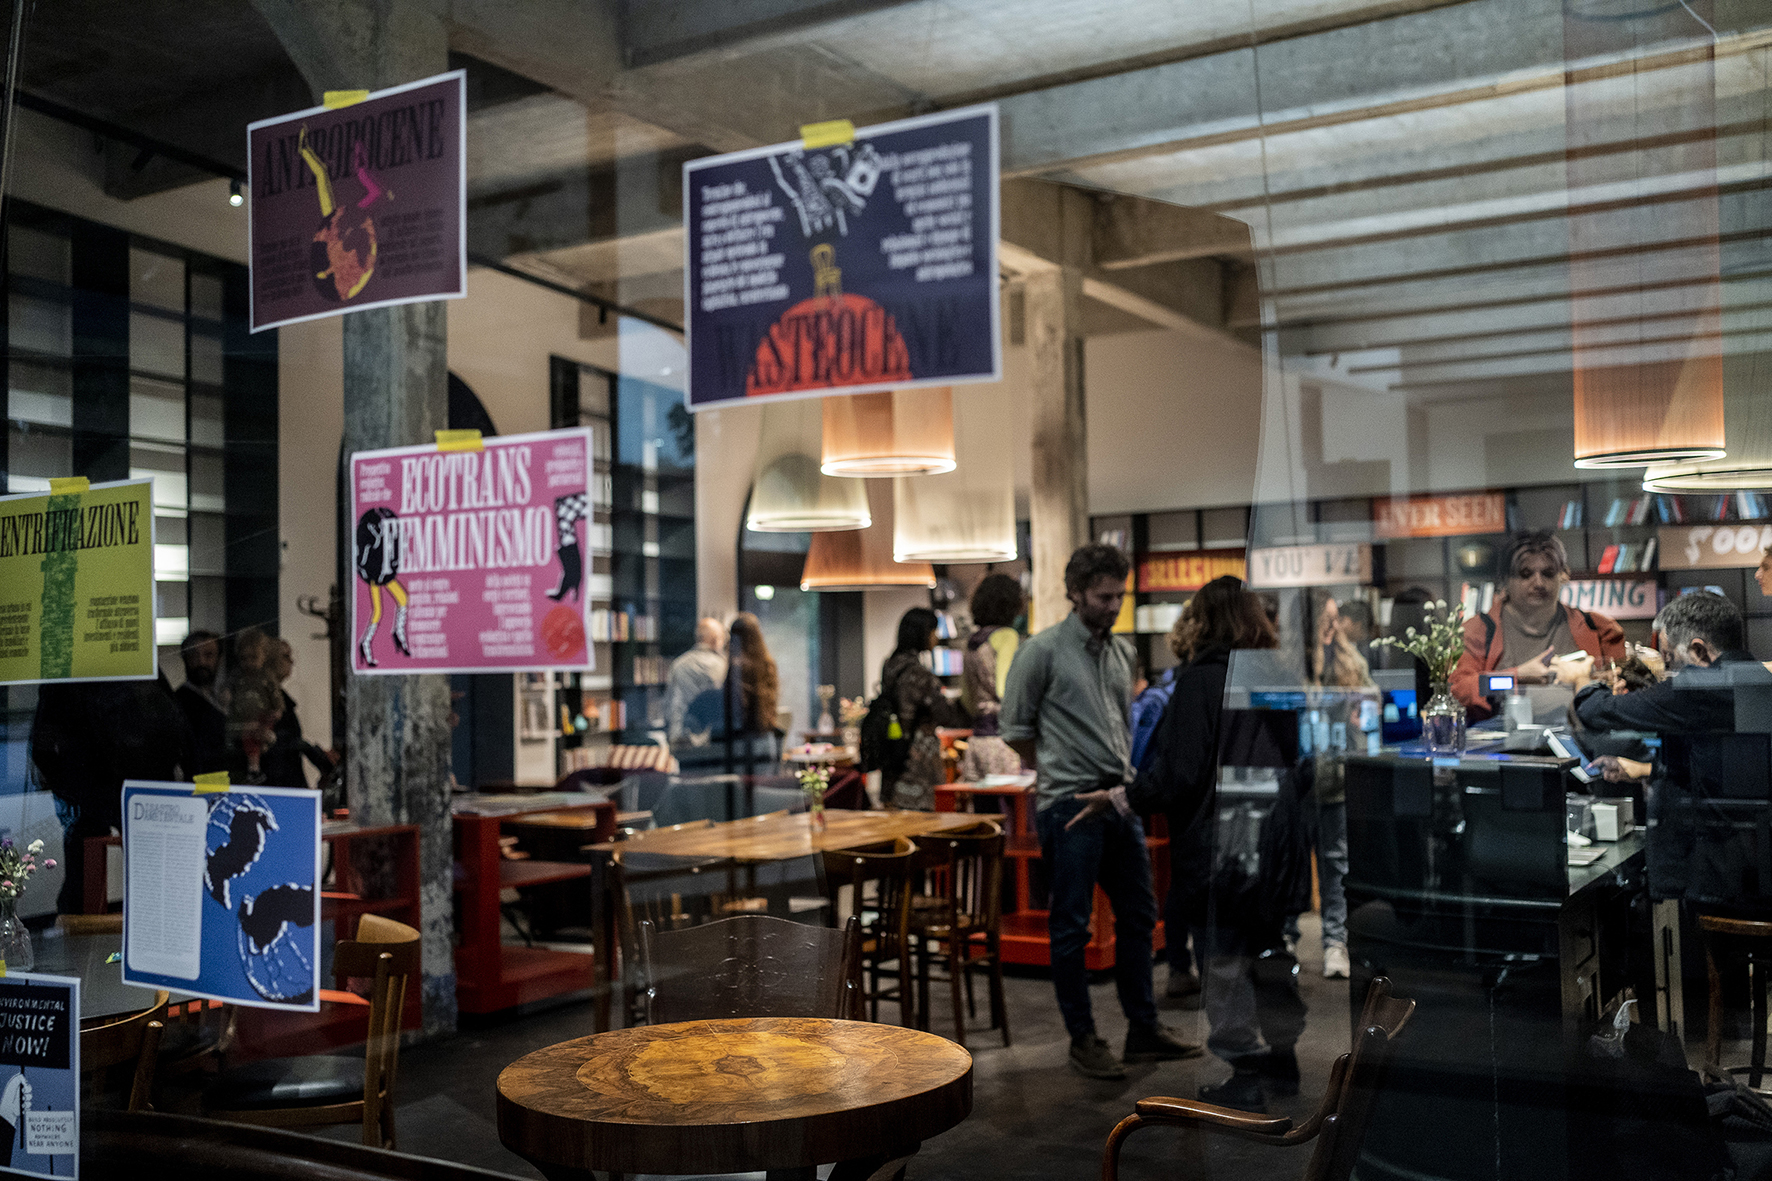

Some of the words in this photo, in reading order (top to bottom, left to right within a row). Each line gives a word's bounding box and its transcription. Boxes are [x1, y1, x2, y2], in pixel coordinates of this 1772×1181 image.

[399, 447, 533, 514] ECOTRANS
[1445, 495, 1501, 527] SEEN
[0, 500, 140, 558] ENTRIFICAZIONE
[380, 505, 552, 575] FEMMINISMO
[1559, 579, 1645, 609] OMING
[0, 997, 65, 1012] NVIRONMENTAL
[0, 1013, 57, 1032] JUSTICE
[2, 1034, 51, 1058] NOW!
[30, 1123, 67, 1133] NOTHING
[46, 1140, 74, 1148] ANYONE
